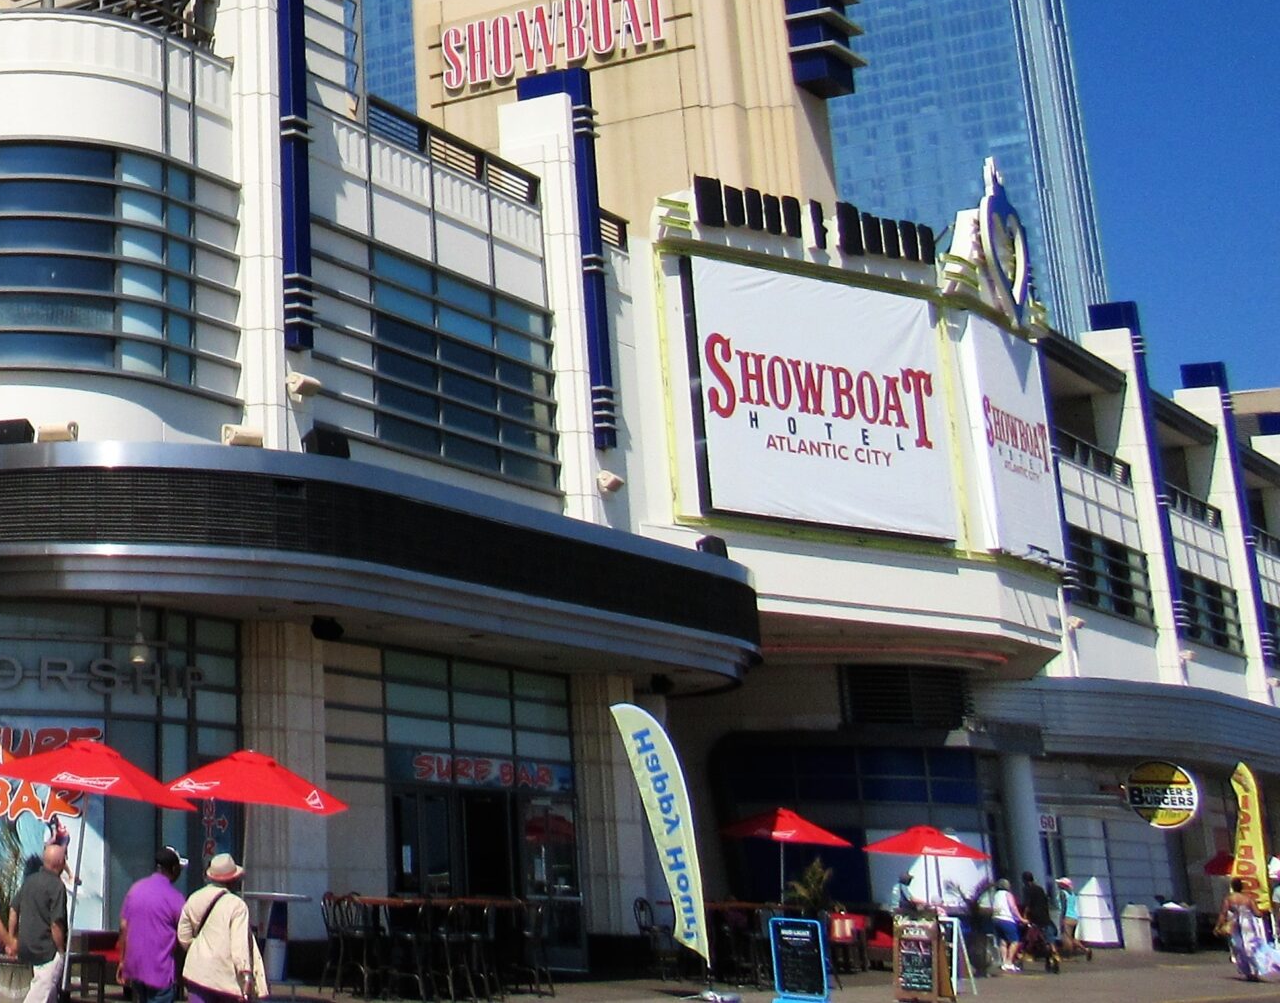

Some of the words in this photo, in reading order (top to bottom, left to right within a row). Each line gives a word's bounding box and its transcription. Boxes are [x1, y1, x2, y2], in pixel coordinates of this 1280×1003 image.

[704, 332, 934, 450] SHOWBOAT
[749, 410, 905, 450] HOTEL
[983, 394, 1049, 472] SHOWBOAT
[766, 434, 849, 461] ATLANTIC
[854, 447, 892, 467] CITY
[413, 754, 493, 784] SURF
[498, 762, 552, 788] BAR
